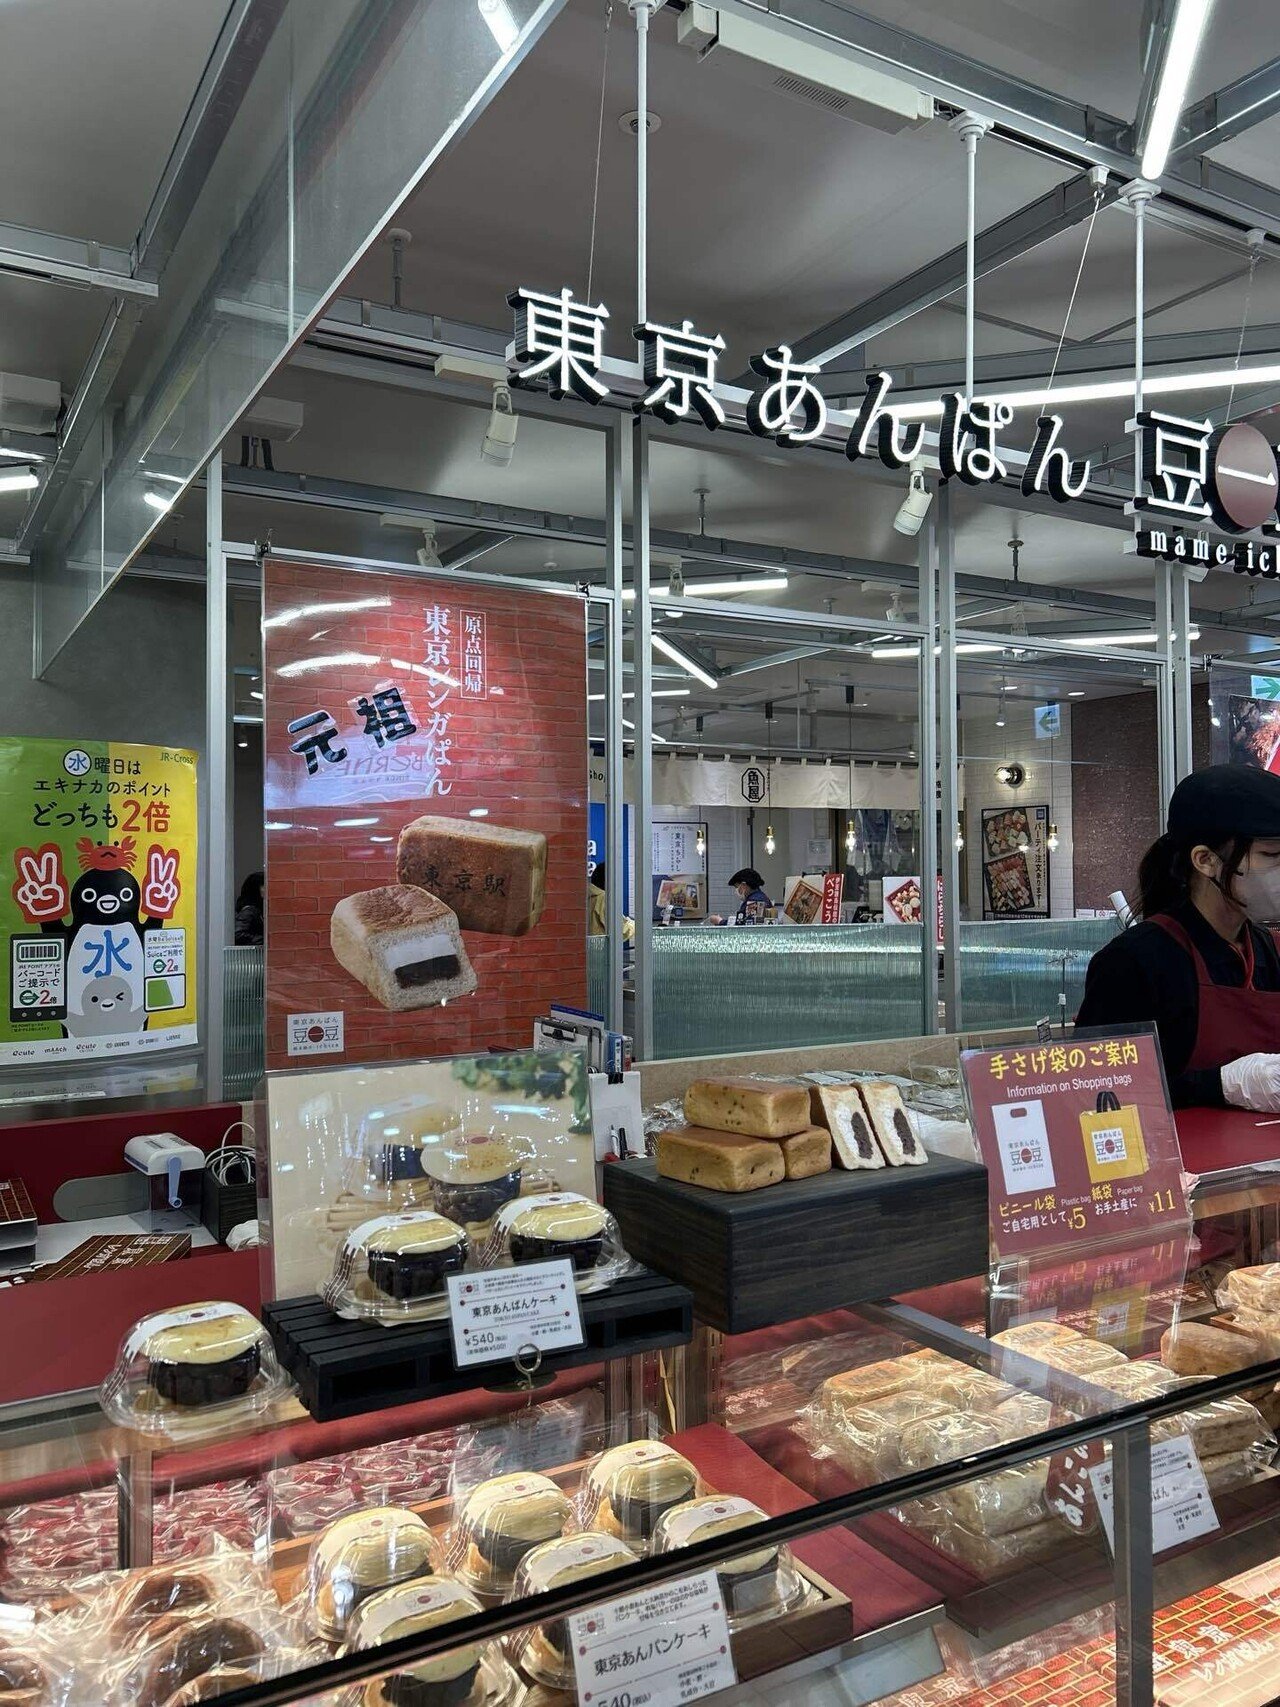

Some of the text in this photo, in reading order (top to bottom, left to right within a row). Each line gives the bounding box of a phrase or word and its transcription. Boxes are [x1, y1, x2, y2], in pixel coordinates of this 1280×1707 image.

[510, 286, 1091, 500] 東京あんぱん
[1147, 410, 1280, 531] 豆一
[464, 614, 483, 693] 原点回帰
[287, 686, 417, 776] 元祖
[63, 749, 142, 776] 水曜日は
[160, 752, 194, 765] JR-Cross
[33, 777, 171, 798] エキナカのポイント
[33, 799, 171, 833] どっちも2倍
[422, 865, 507, 897] 東京駅
[81, 930, 133, 978] 水
[17, 968, 61, 978] バーコード
[18, 977, 61, 988] ご提示で
[989, 1040, 1139, 1080] 手さげ袋のご案内
[1006, 1073, 1132, 1098] Information on Shopping bags
[1060, 1194, 1092, 1207] Plastic bag
[1091, 1183, 1113, 1202] 紙袋
[1095, 1188, 1176, 1216] お手土産に ¥11
[1116, 1184, 1143, 1197] Paper bag
[1002, 1207, 1087, 1234] ご自宅用として ¥5
[471, 1294, 558, 1318] 東京あんぱんケーキ
[465, 1332, 494, 1347] ¥540
[594, 1623, 711, 1677] 東京あんパンケーキ
